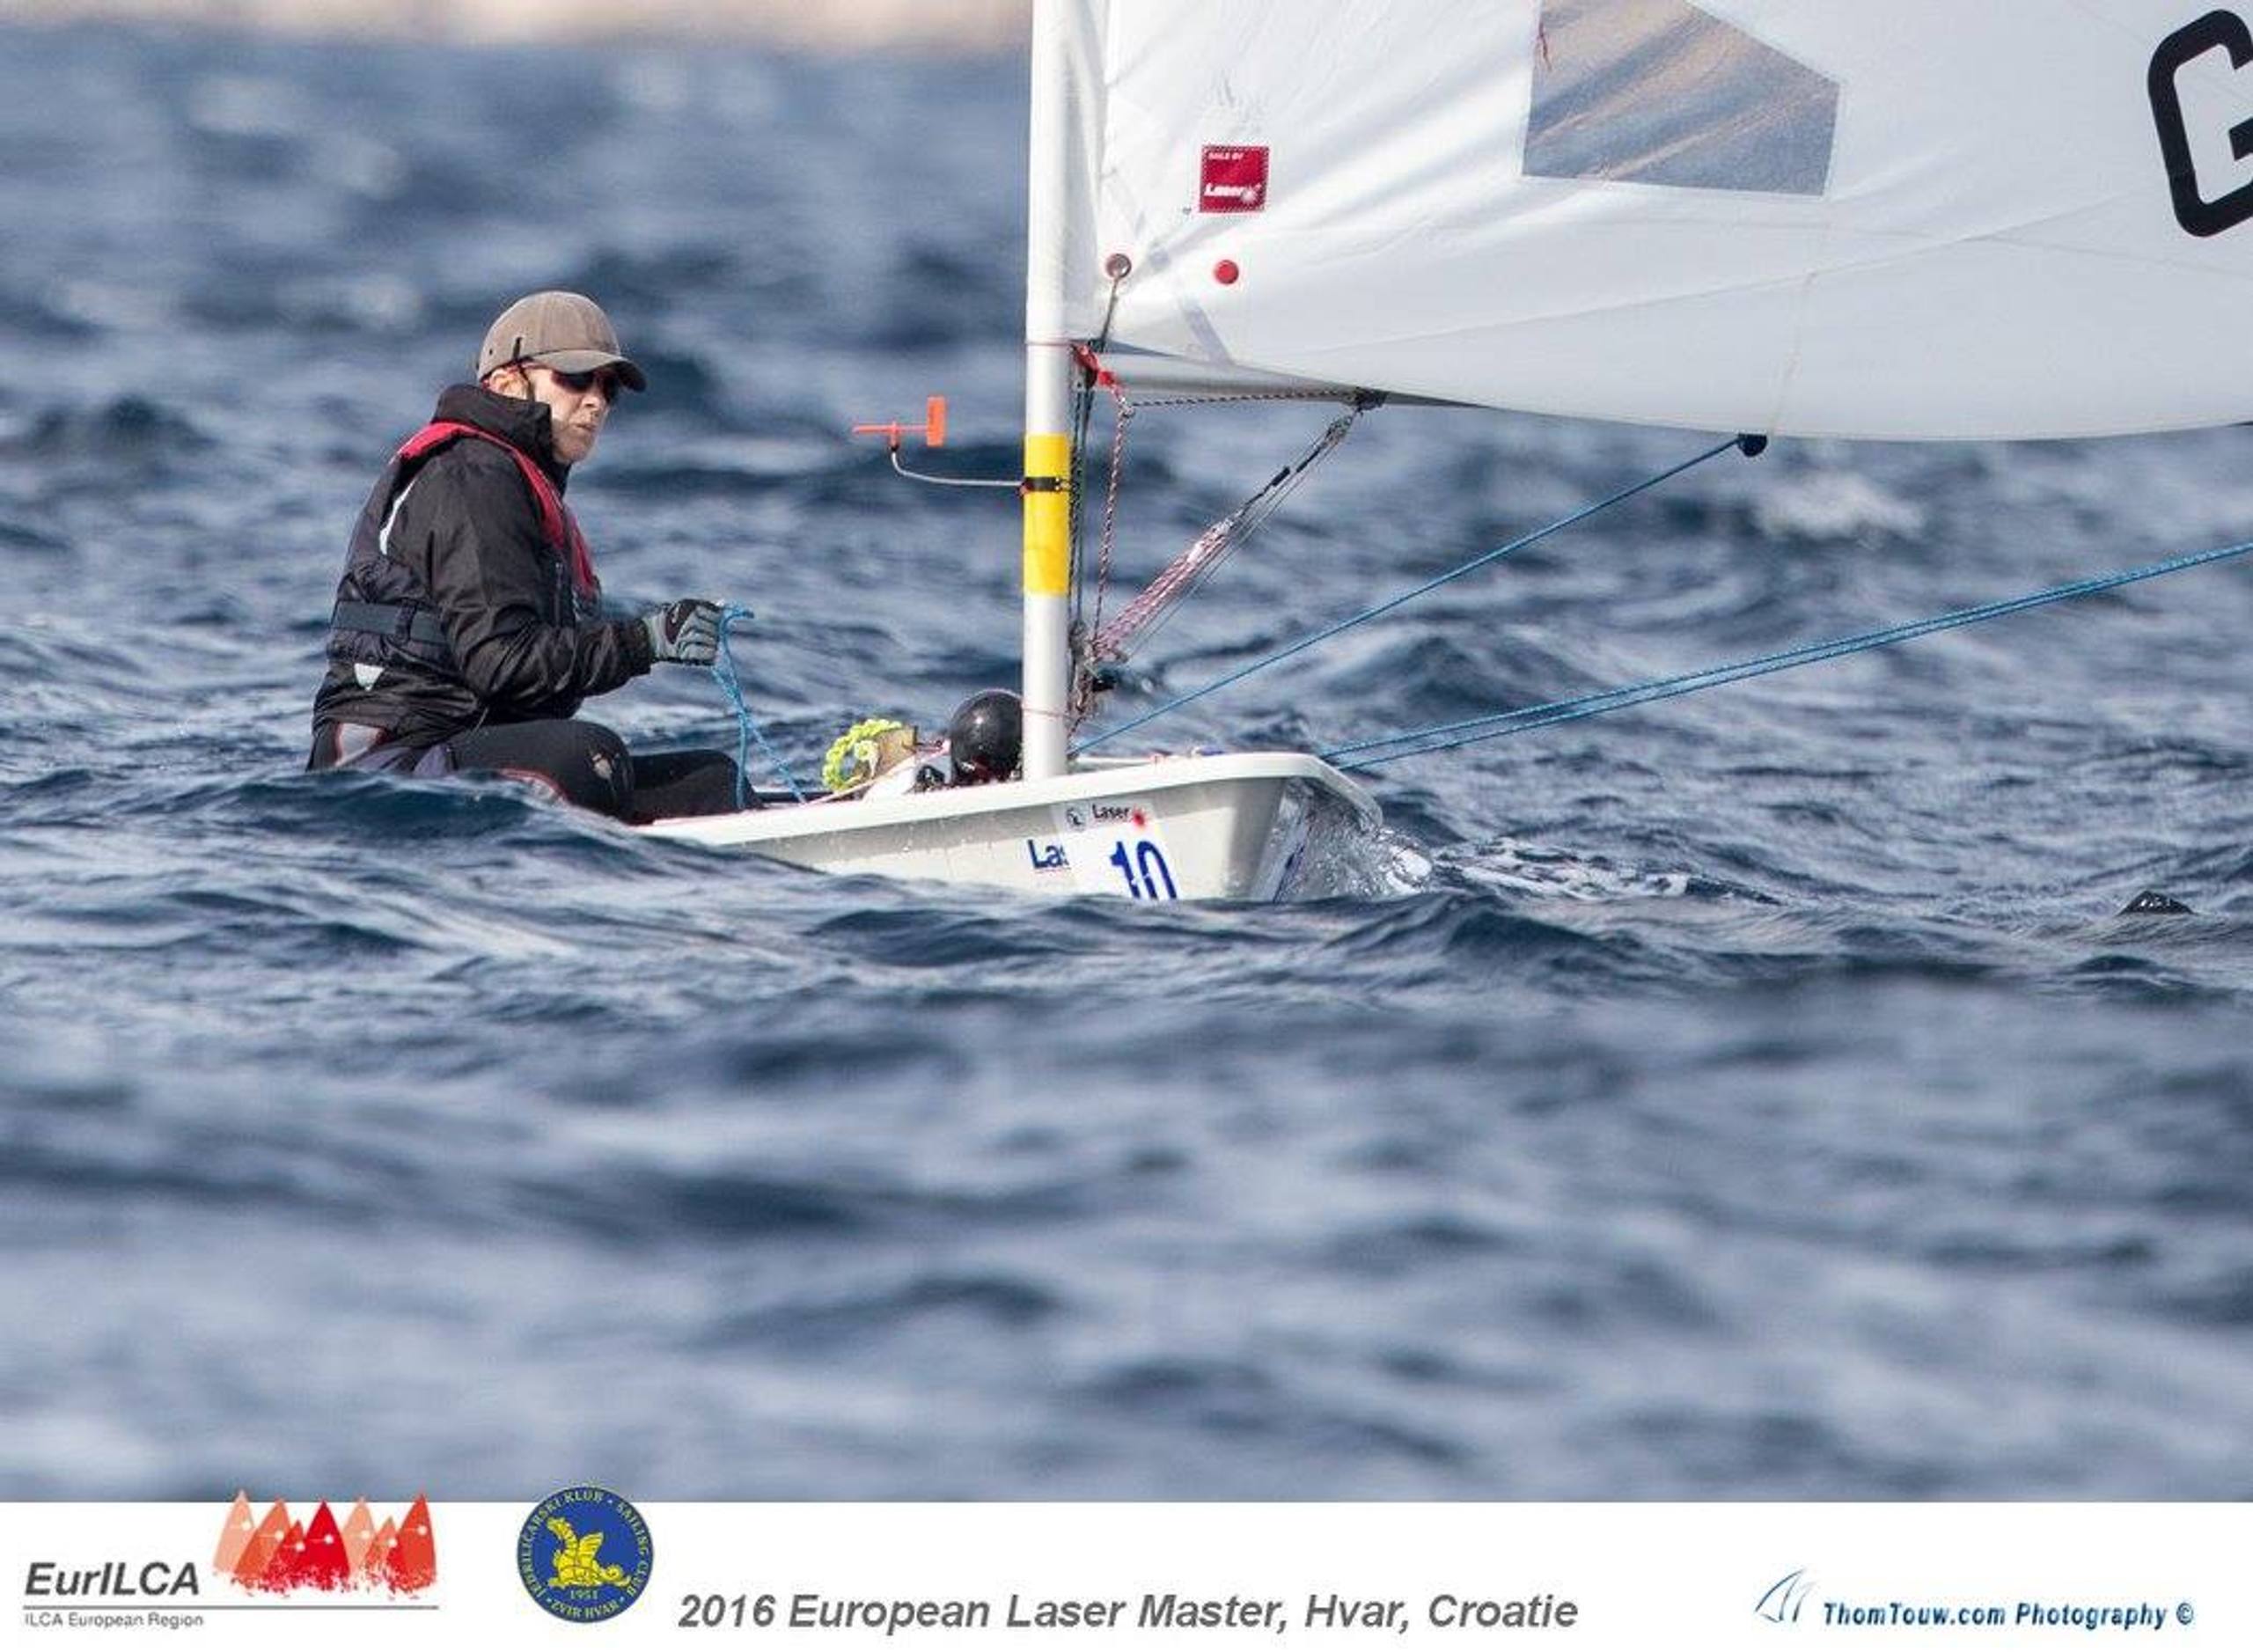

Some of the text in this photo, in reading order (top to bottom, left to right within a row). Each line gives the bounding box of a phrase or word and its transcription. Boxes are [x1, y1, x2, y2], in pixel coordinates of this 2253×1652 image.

[2147, 9, 2253, 238] G
[1091, 804, 1130, 820] Laser
[1109, 840, 1178, 899] 10
